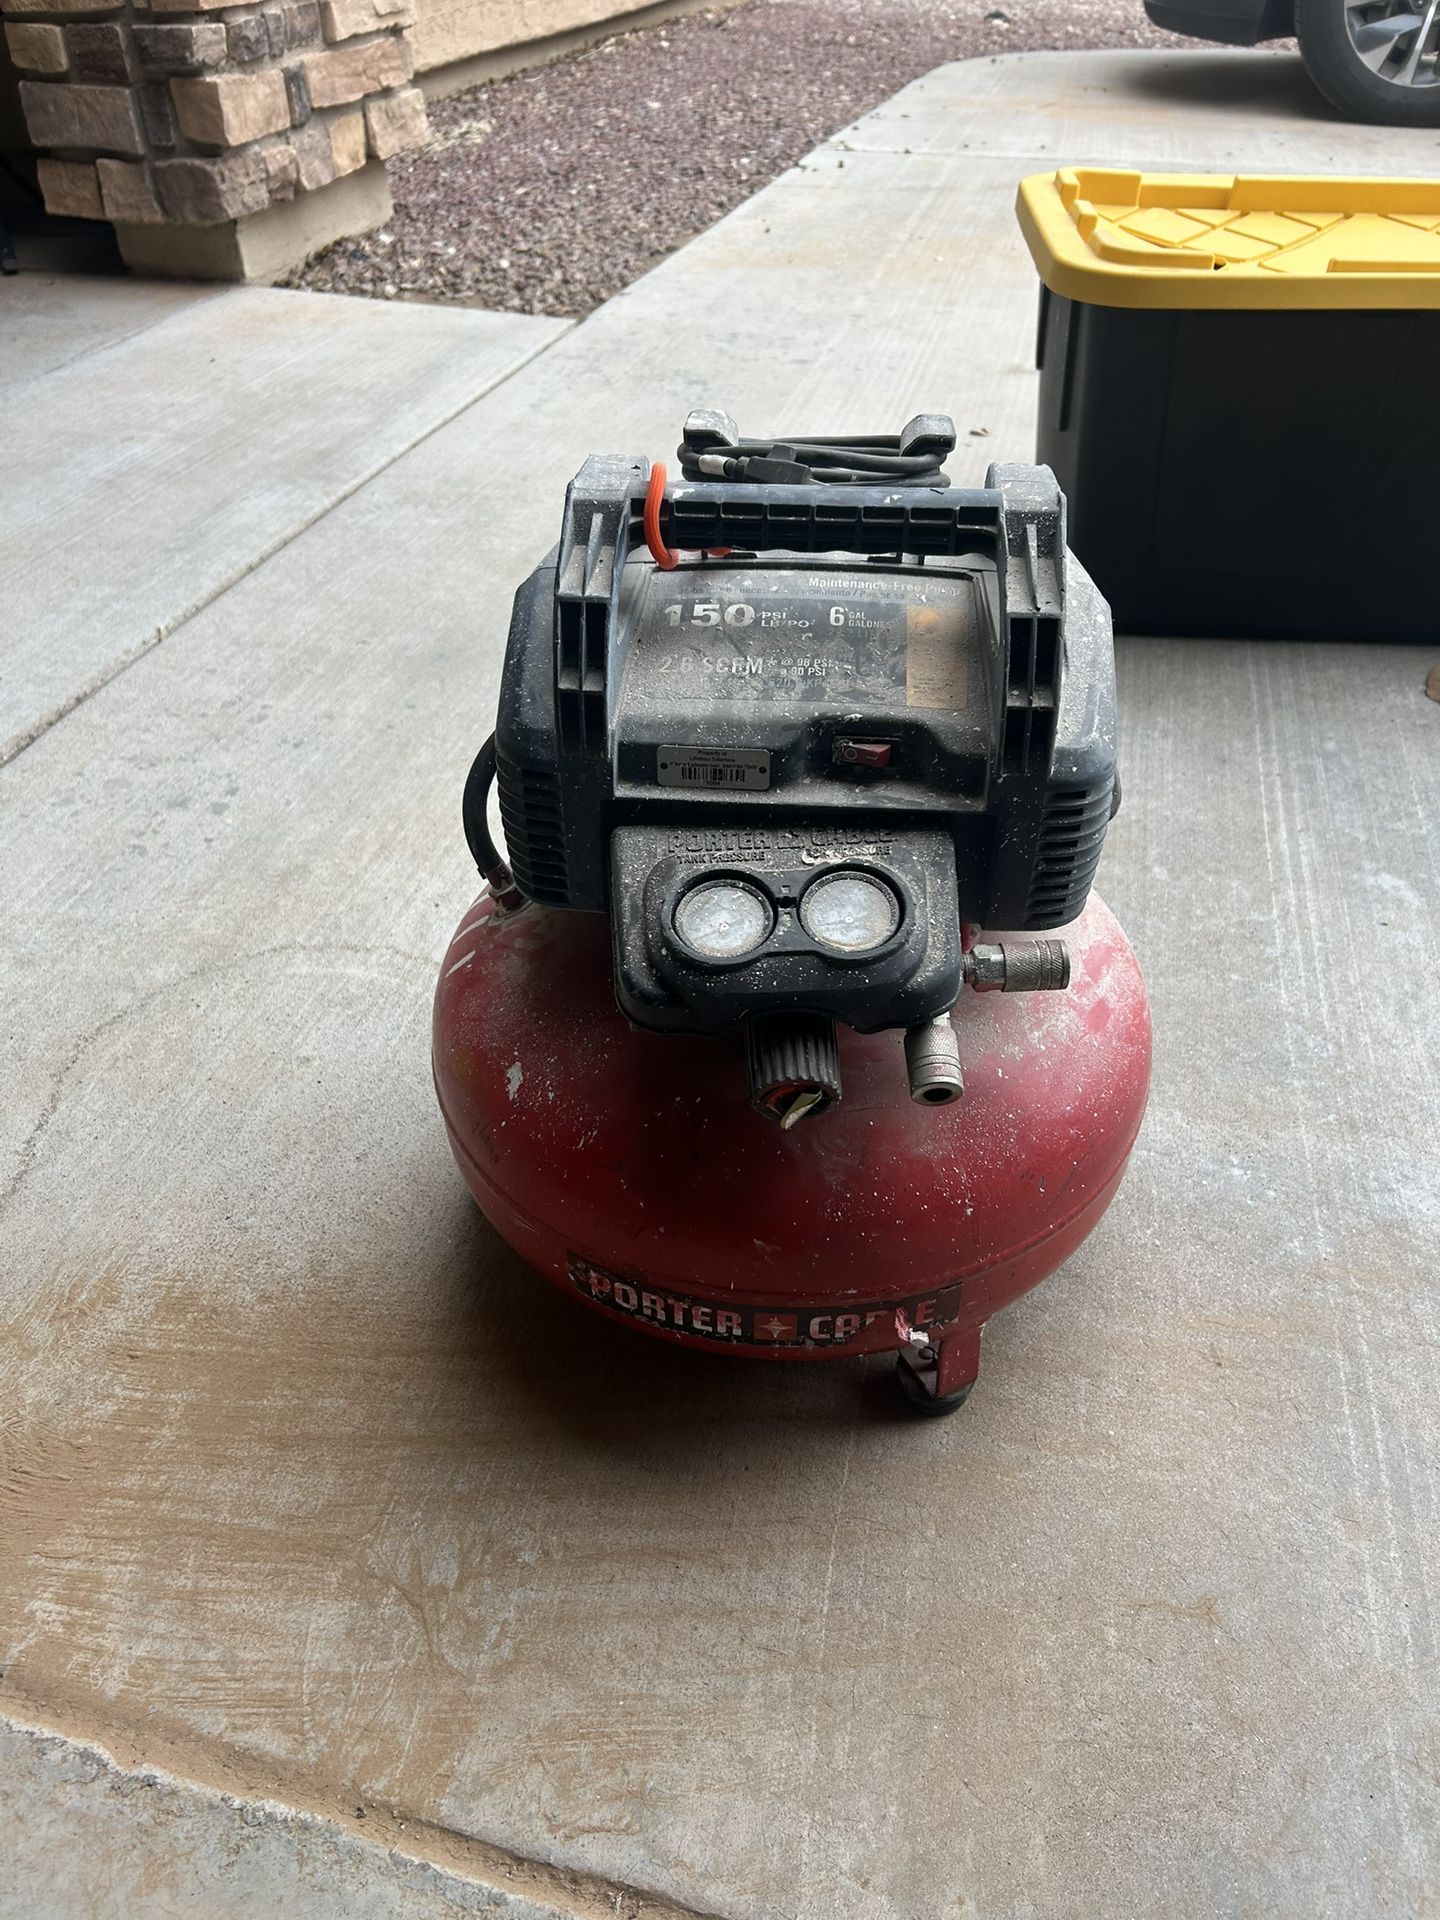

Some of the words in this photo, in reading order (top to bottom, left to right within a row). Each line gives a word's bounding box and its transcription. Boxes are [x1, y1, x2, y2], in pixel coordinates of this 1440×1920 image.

[664, 603, 756, 627] 150
[761, 611, 787, 620] PSI
[829, 606, 845, 626] 6
[848, 611, 867, 620] GAL
[848, 620, 889, 628] GALON
[791, 666, 804, 676] 90
[808, 667, 826, 676] PSI
[588, 1270, 742, 1336] PORTER
[809, 1298, 937, 1340] CAE
